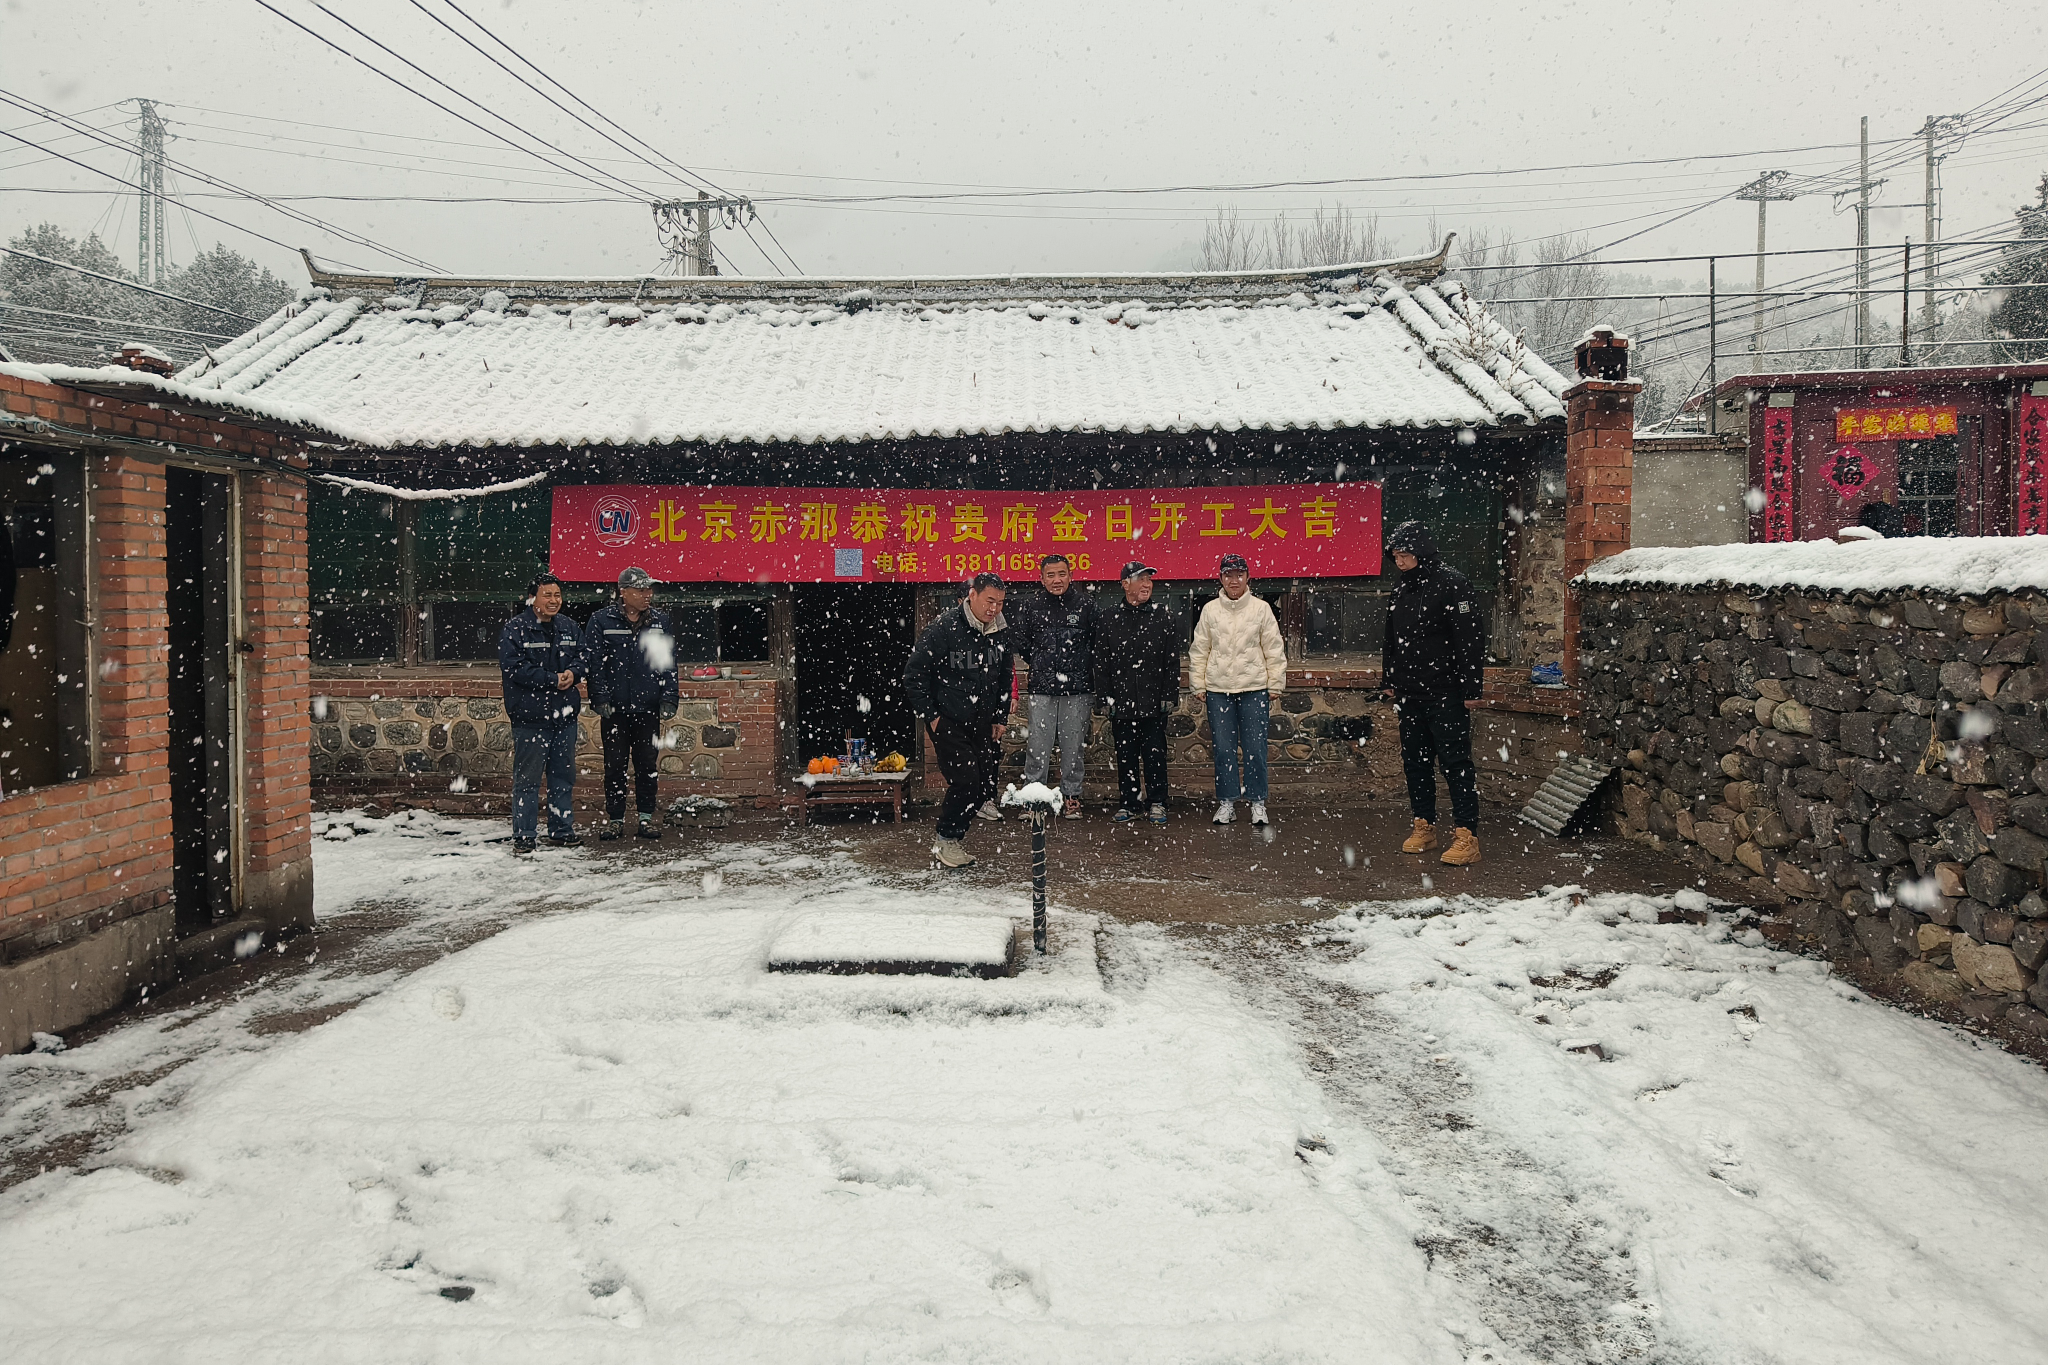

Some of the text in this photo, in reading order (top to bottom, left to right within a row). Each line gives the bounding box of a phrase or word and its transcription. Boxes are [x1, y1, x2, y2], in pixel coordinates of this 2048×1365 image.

[1832, 455, 1866, 486] 福
[649, 495, 1339, 543] 北京赤那恭祝贵府金日开工大吉
[943, 552, 1091, 571] 138116586
